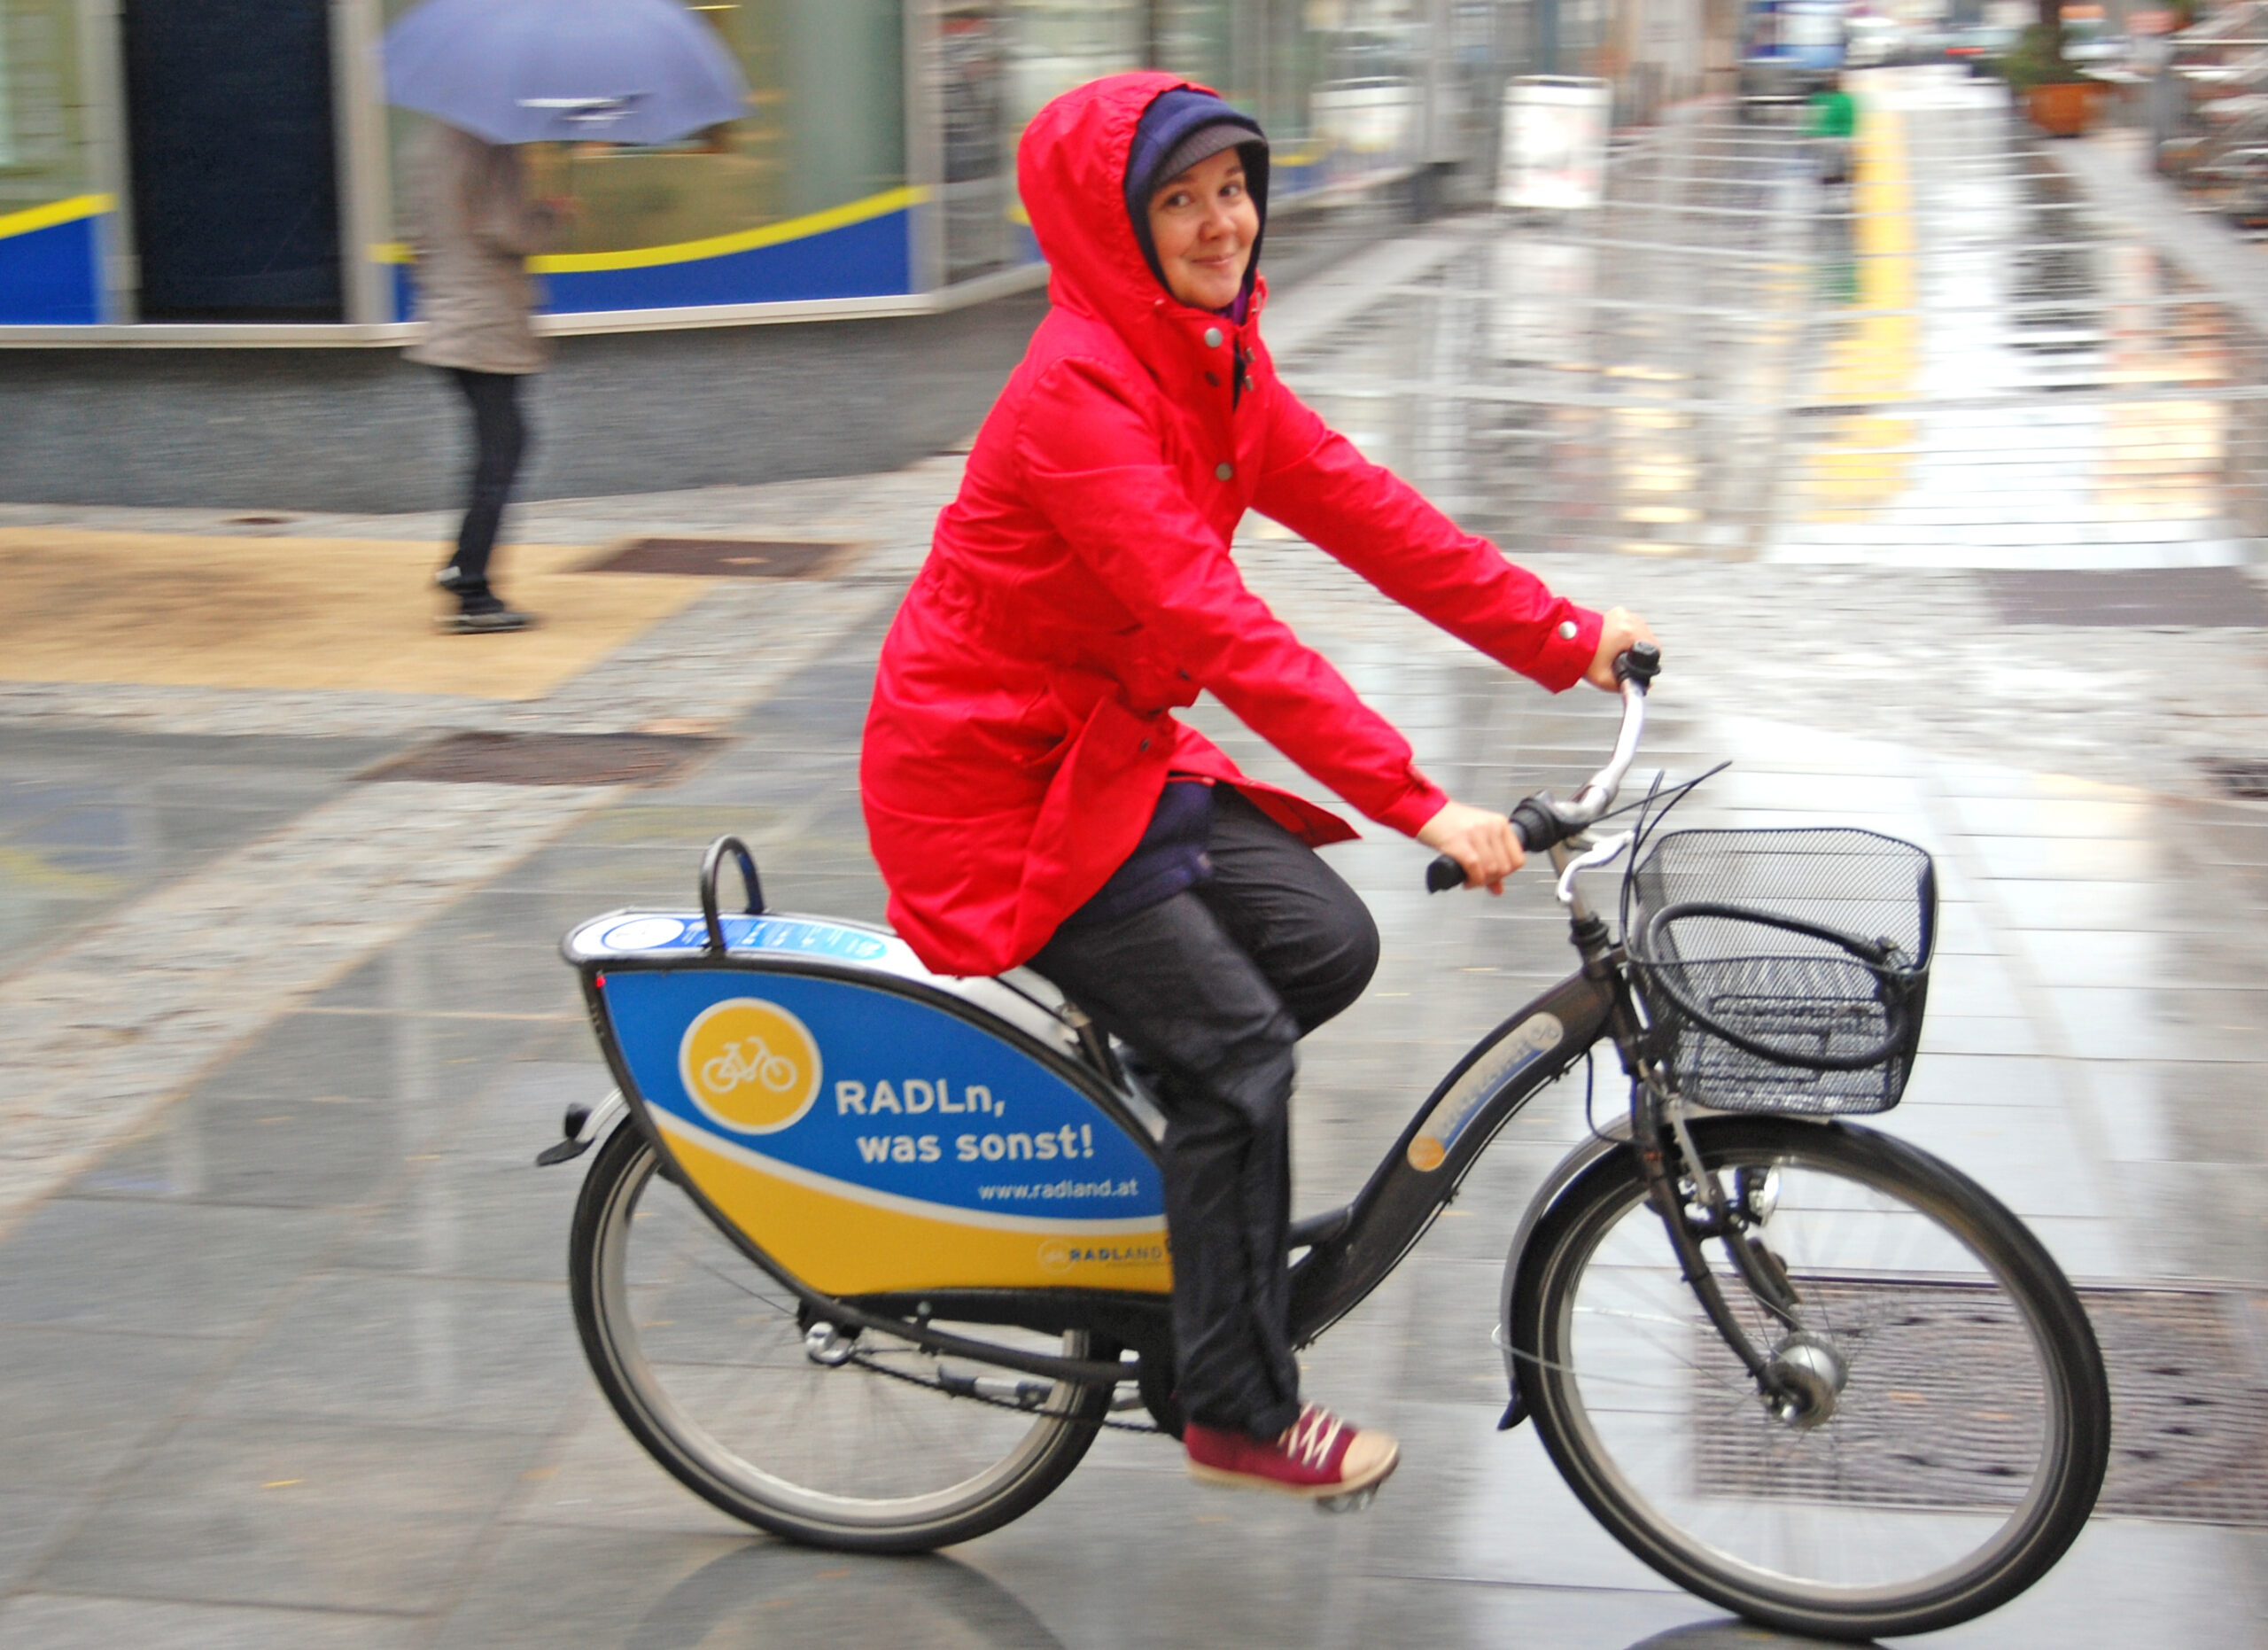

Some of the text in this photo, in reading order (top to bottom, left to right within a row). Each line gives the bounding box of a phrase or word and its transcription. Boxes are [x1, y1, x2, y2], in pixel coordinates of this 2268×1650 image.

[835, 1078, 1006, 1118] RADLn,
[856, 1124, 1095, 1164] was sonst!
[978, 1178, 1138, 1200] www.radland.at
[1068, 1245, 1163, 1262] RADLAND
